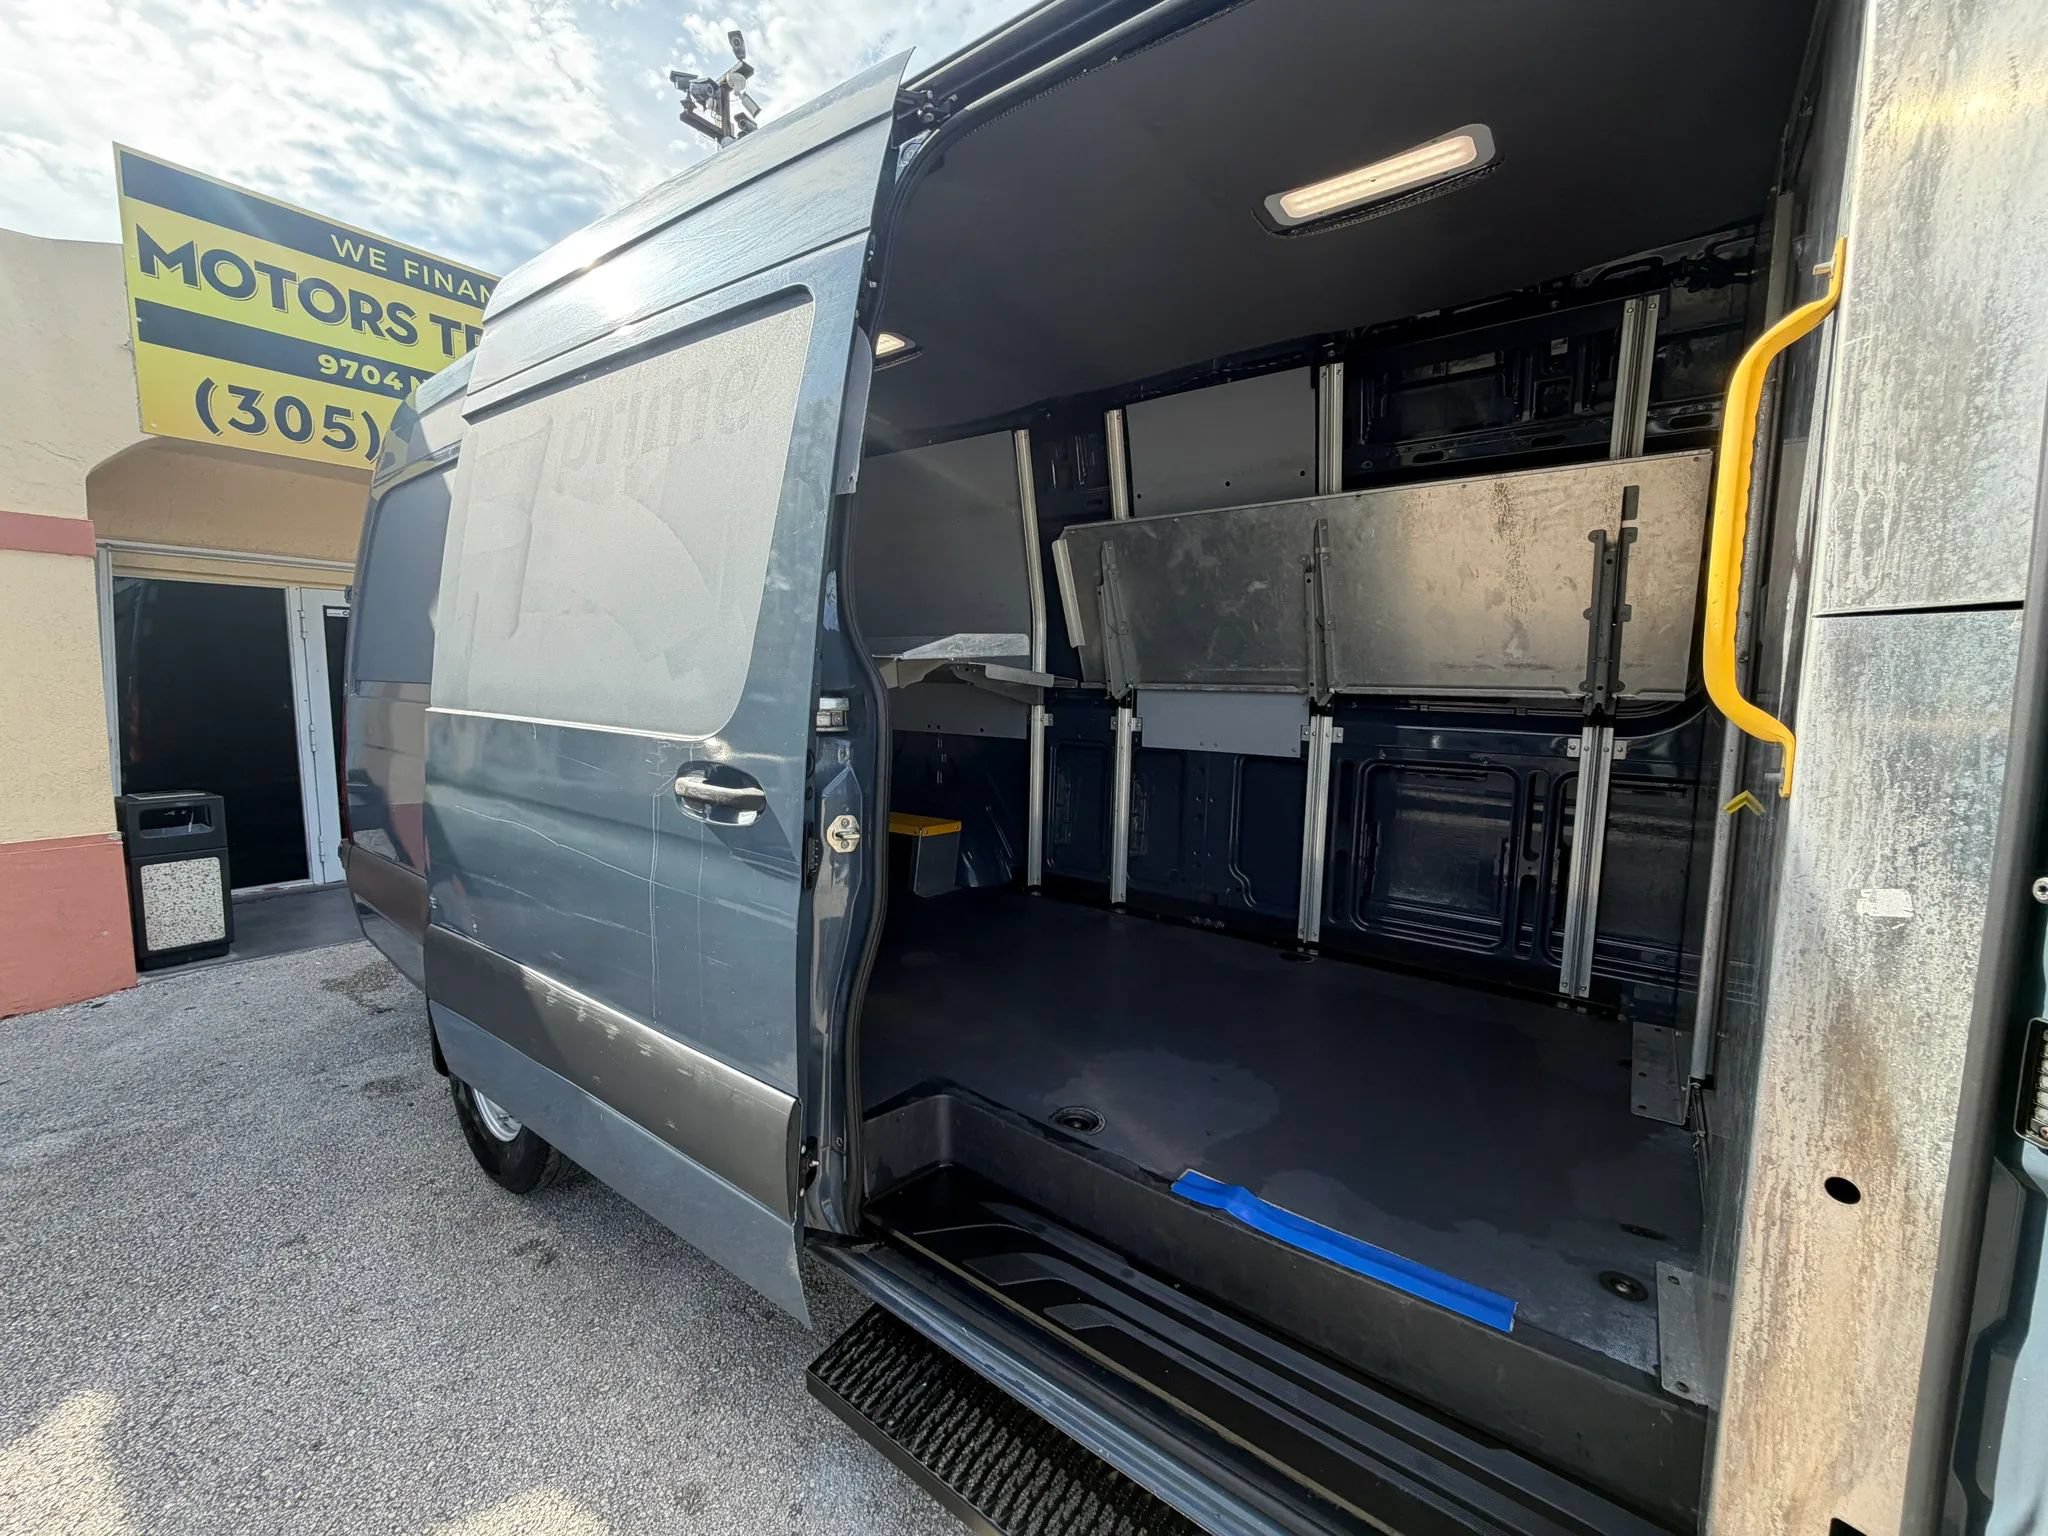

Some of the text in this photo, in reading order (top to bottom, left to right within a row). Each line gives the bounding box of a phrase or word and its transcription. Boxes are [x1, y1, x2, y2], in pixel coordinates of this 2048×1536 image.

[330, 234, 388, 272] WE
[136, 224, 420, 347] MOTORS
[317, 354, 404, 391] 9704
[194, 377, 384, 464] (305)
